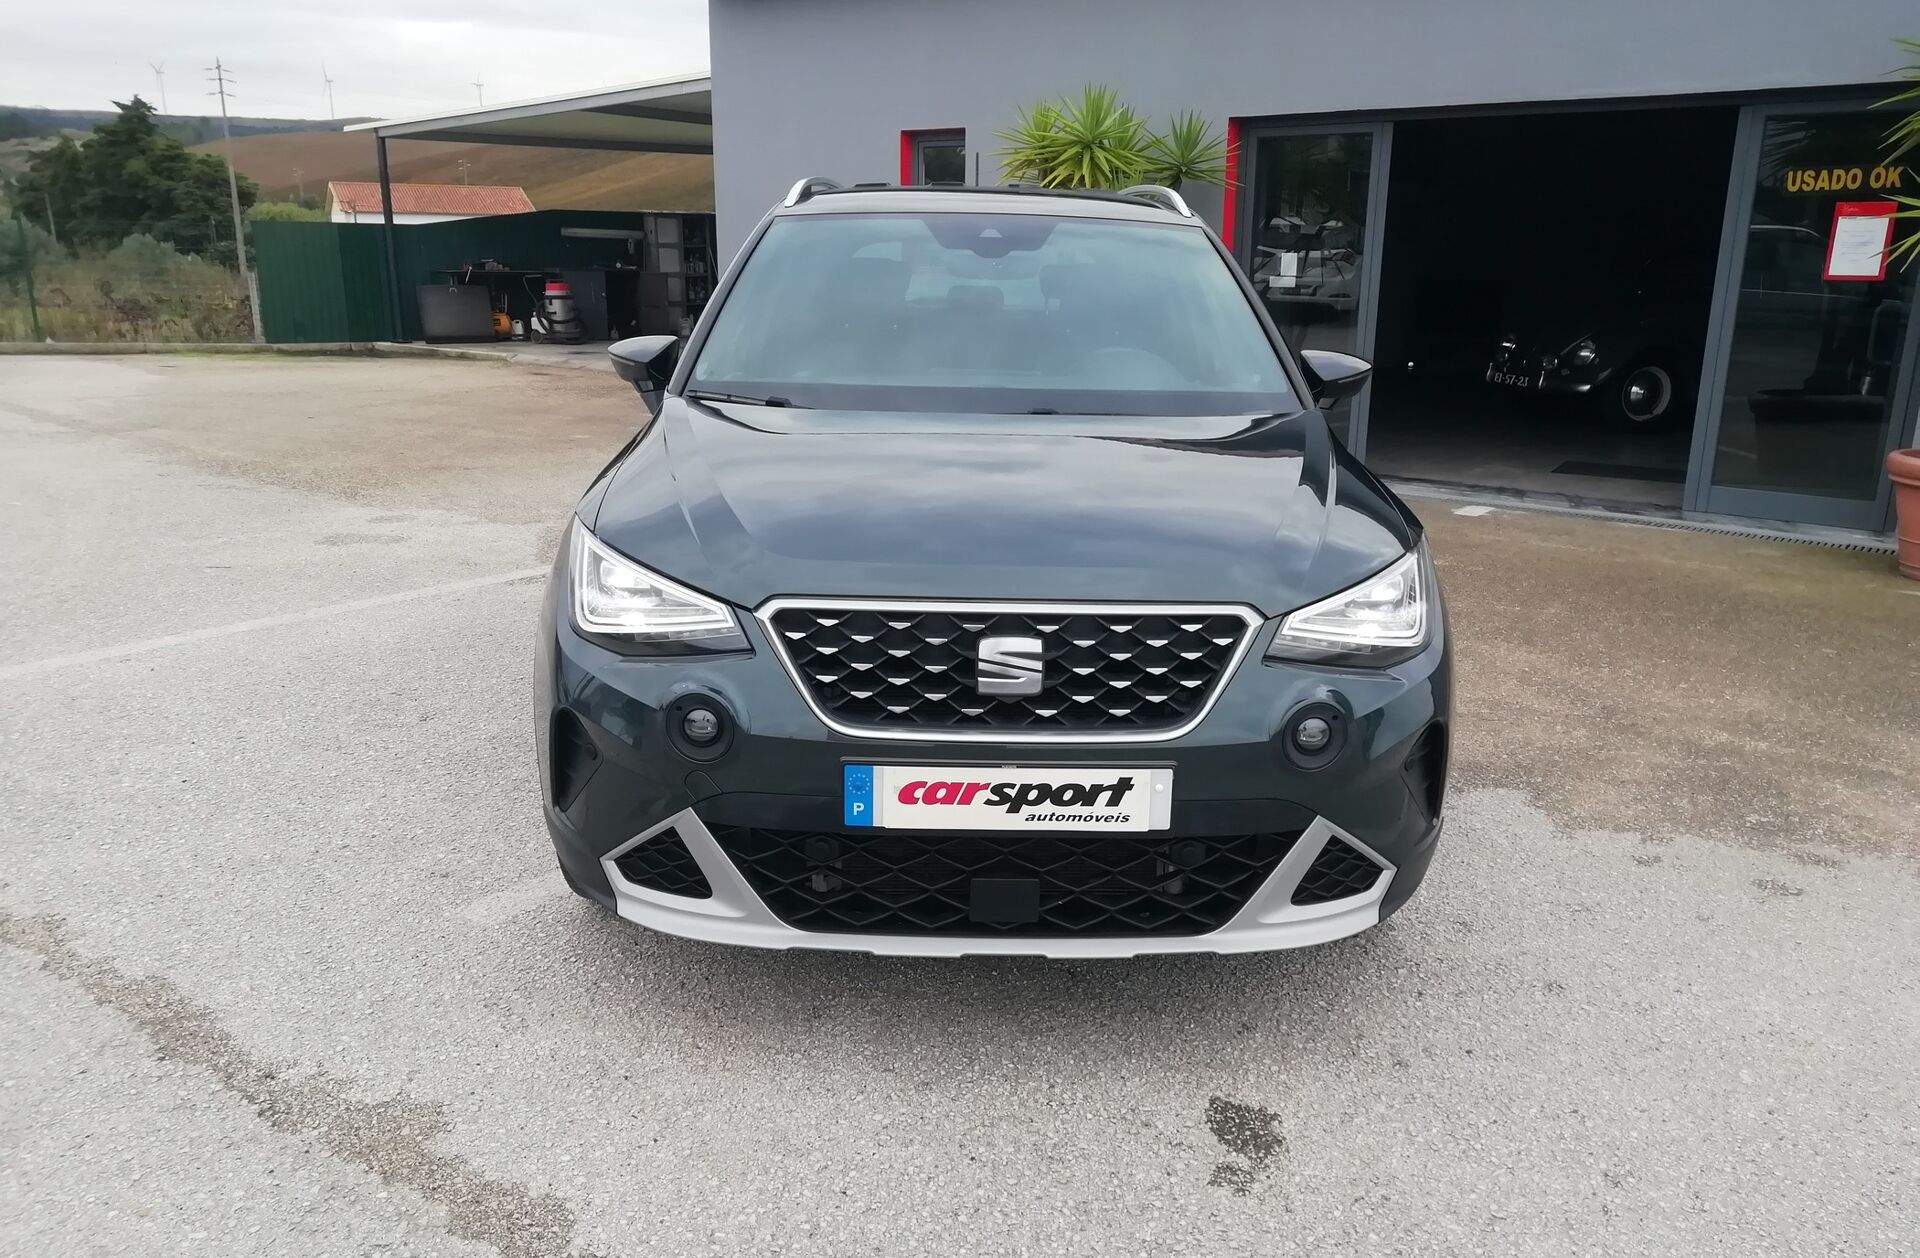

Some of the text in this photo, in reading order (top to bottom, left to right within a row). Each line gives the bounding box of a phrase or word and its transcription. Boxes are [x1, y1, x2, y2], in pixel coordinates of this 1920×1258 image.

[1786, 166, 1904, 192] USADO OK
[897, 776, 1135, 814] carsport
[853, 803, 864, 816] P
[1024, 811, 1131, 824] automóveis
